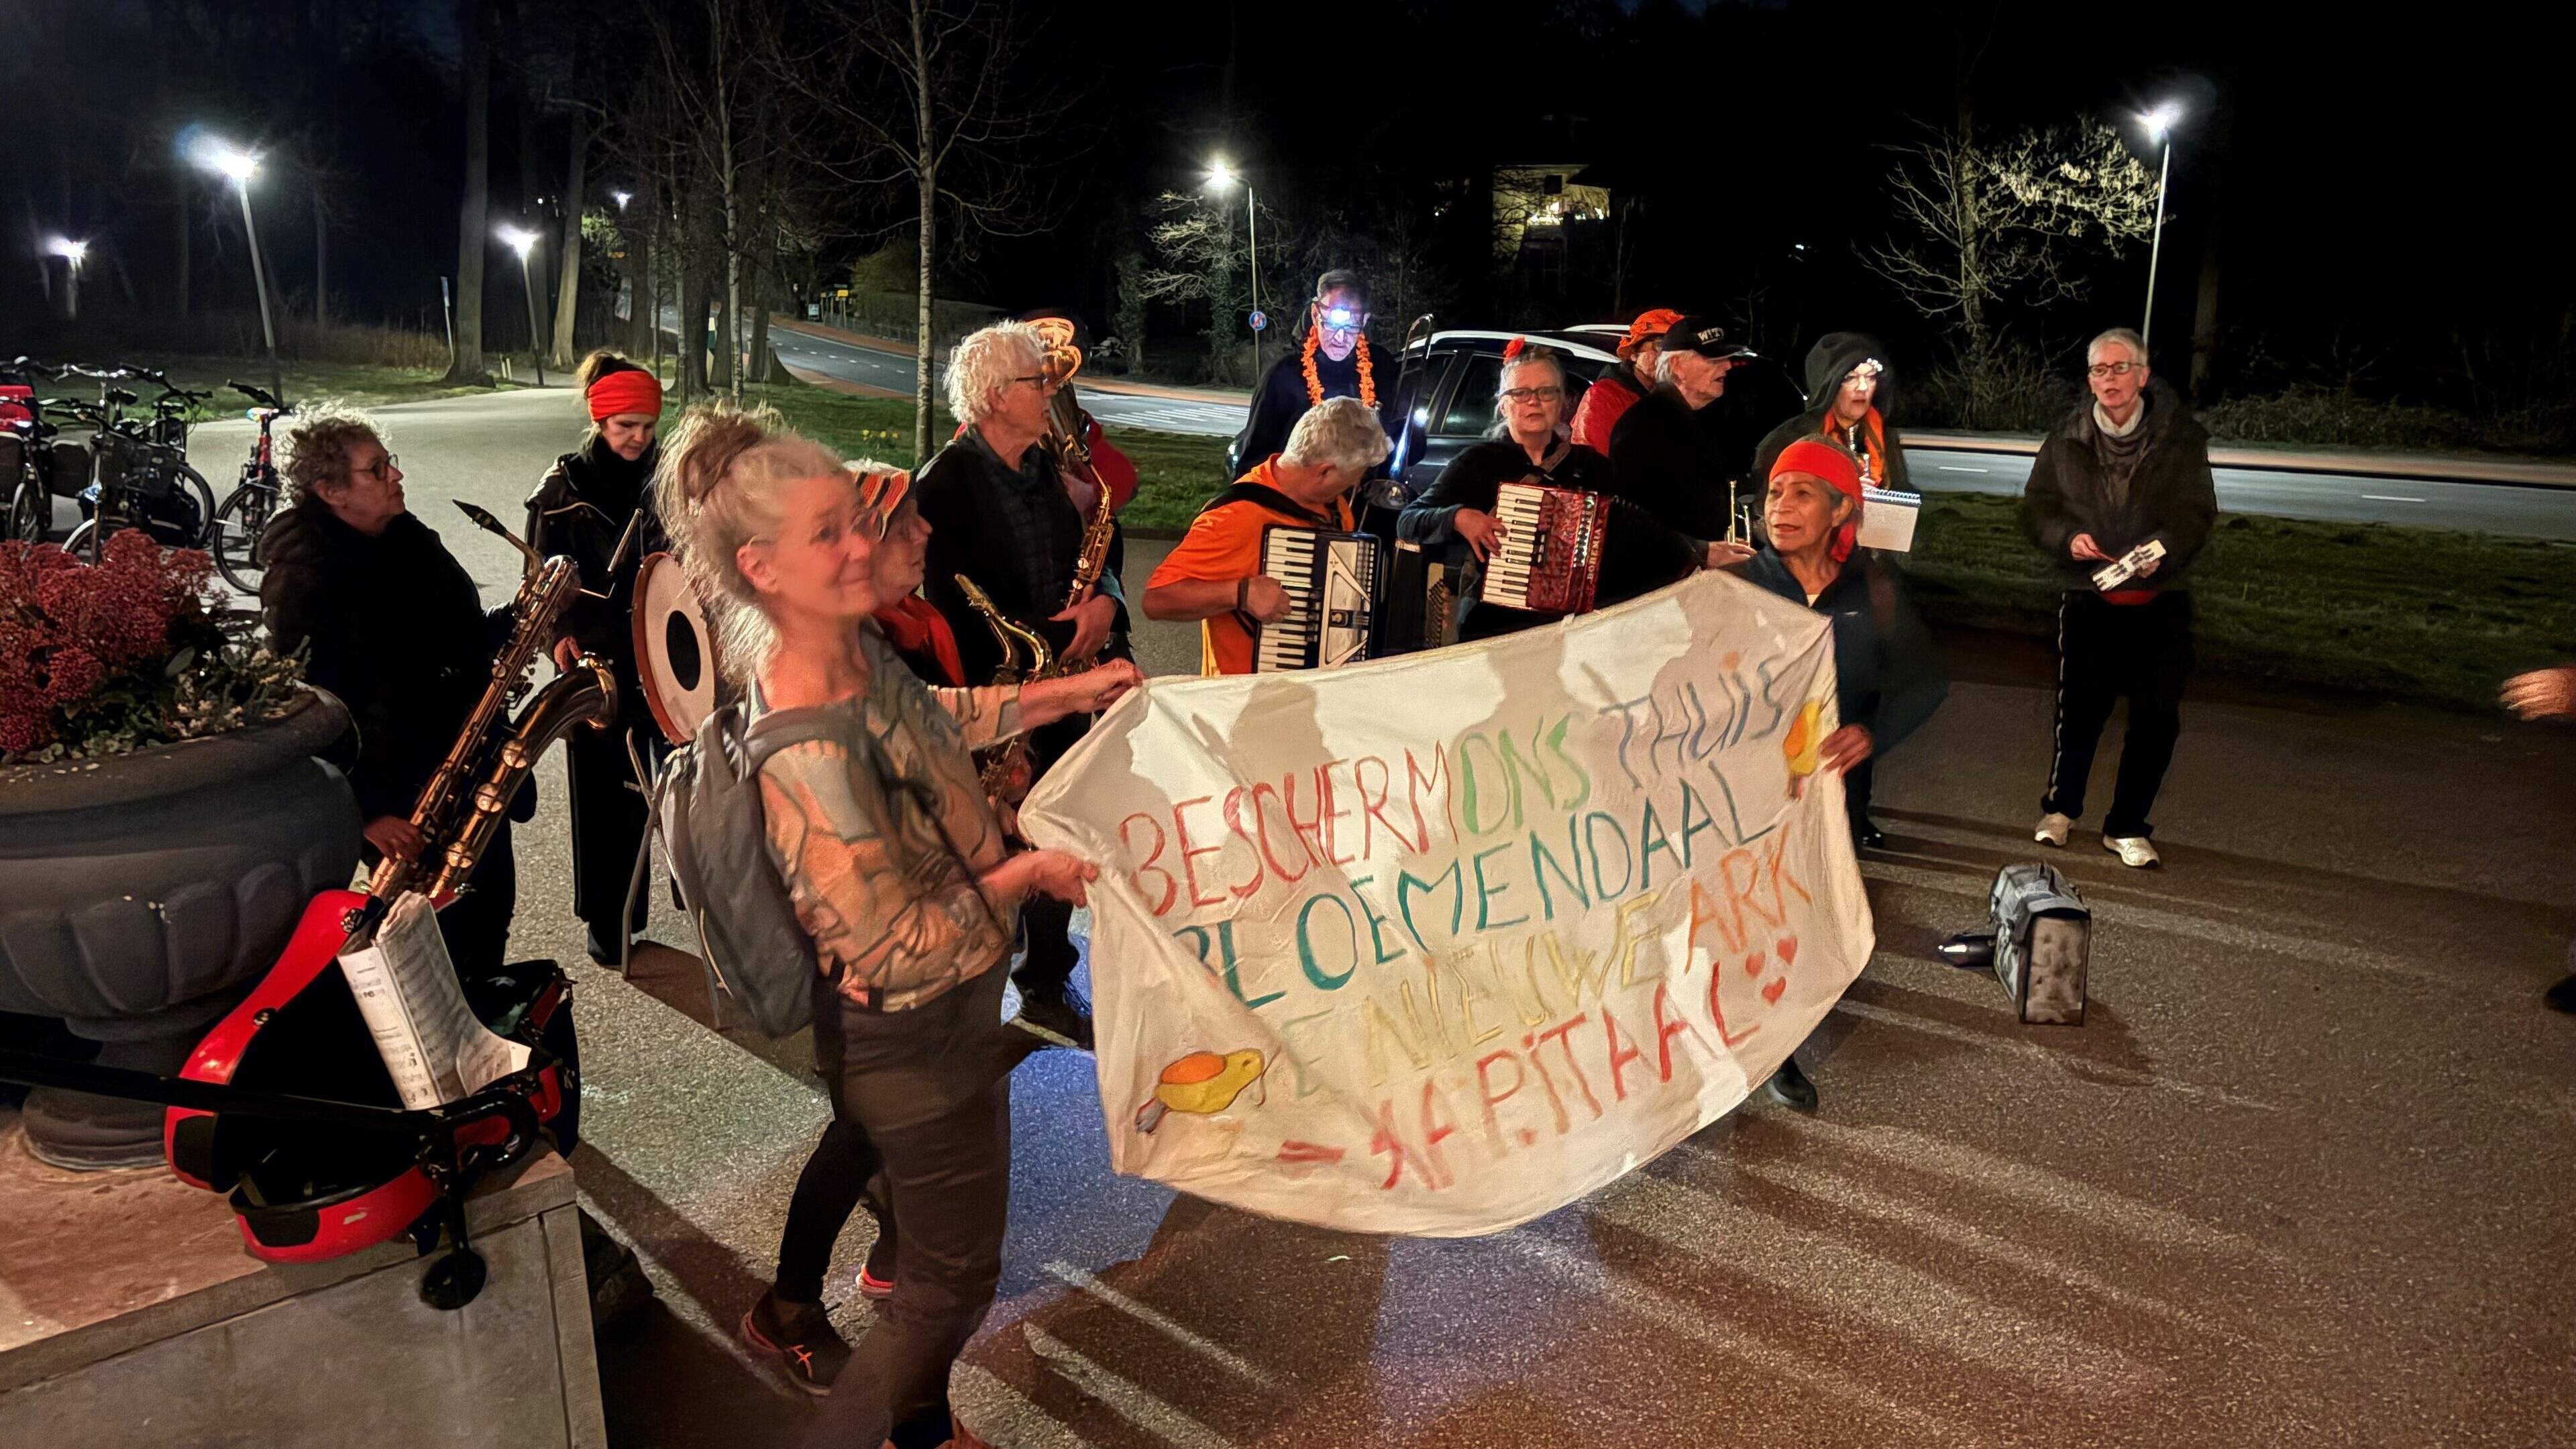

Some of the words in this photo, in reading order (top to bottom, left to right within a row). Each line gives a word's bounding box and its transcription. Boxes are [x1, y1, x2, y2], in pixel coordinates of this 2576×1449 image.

[1119, 739, 1459, 917] BESCHERM
[1460, 712, 1591, 835] ONS
[1599, 651, 1785, 792] THUIS
[1684, 822, 1814, 975] ARK
